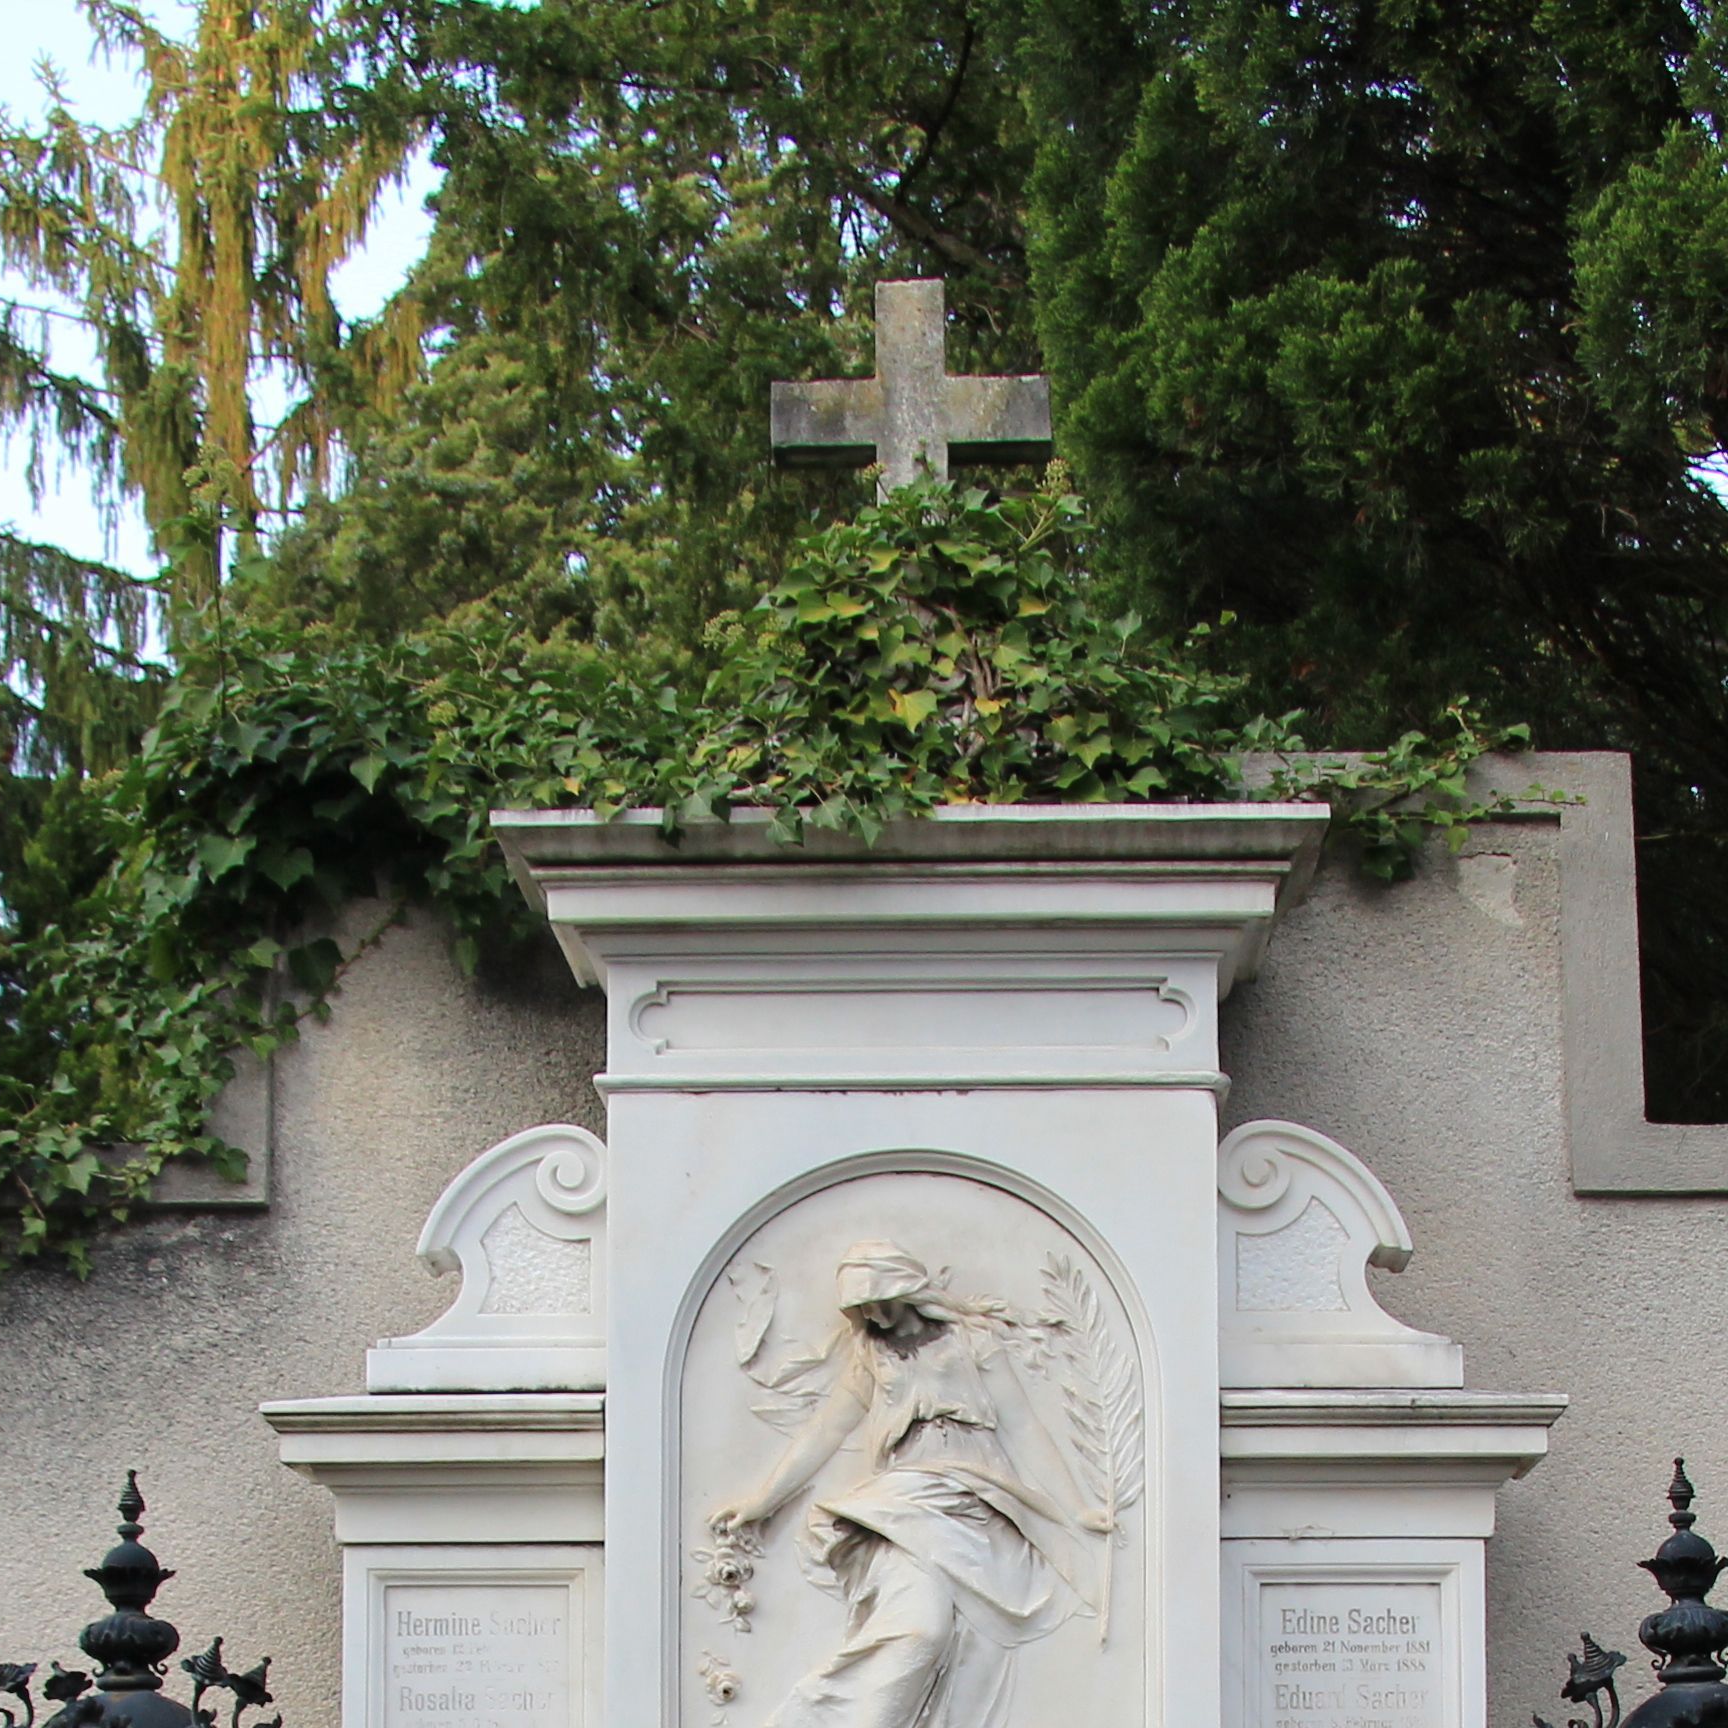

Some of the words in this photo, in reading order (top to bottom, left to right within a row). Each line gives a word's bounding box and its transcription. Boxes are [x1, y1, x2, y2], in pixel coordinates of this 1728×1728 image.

[396, 1609, 482, 1638] Hermine
[1280, 1608, 1340, 1635] Edine
[1347, 1607, 1421, 1635] Sacher
[1269, 1640, 1318, 1658] geboren
[1340, 1640, 1402, 1654] November
[1274, 1658, 1336, 1676] gestorben
[399, 1685, 476, 1712] Rosalia
[1274, 1682, 1346, 1710] Eduard
[1355, 1682, 1429, 1711] Sacher
